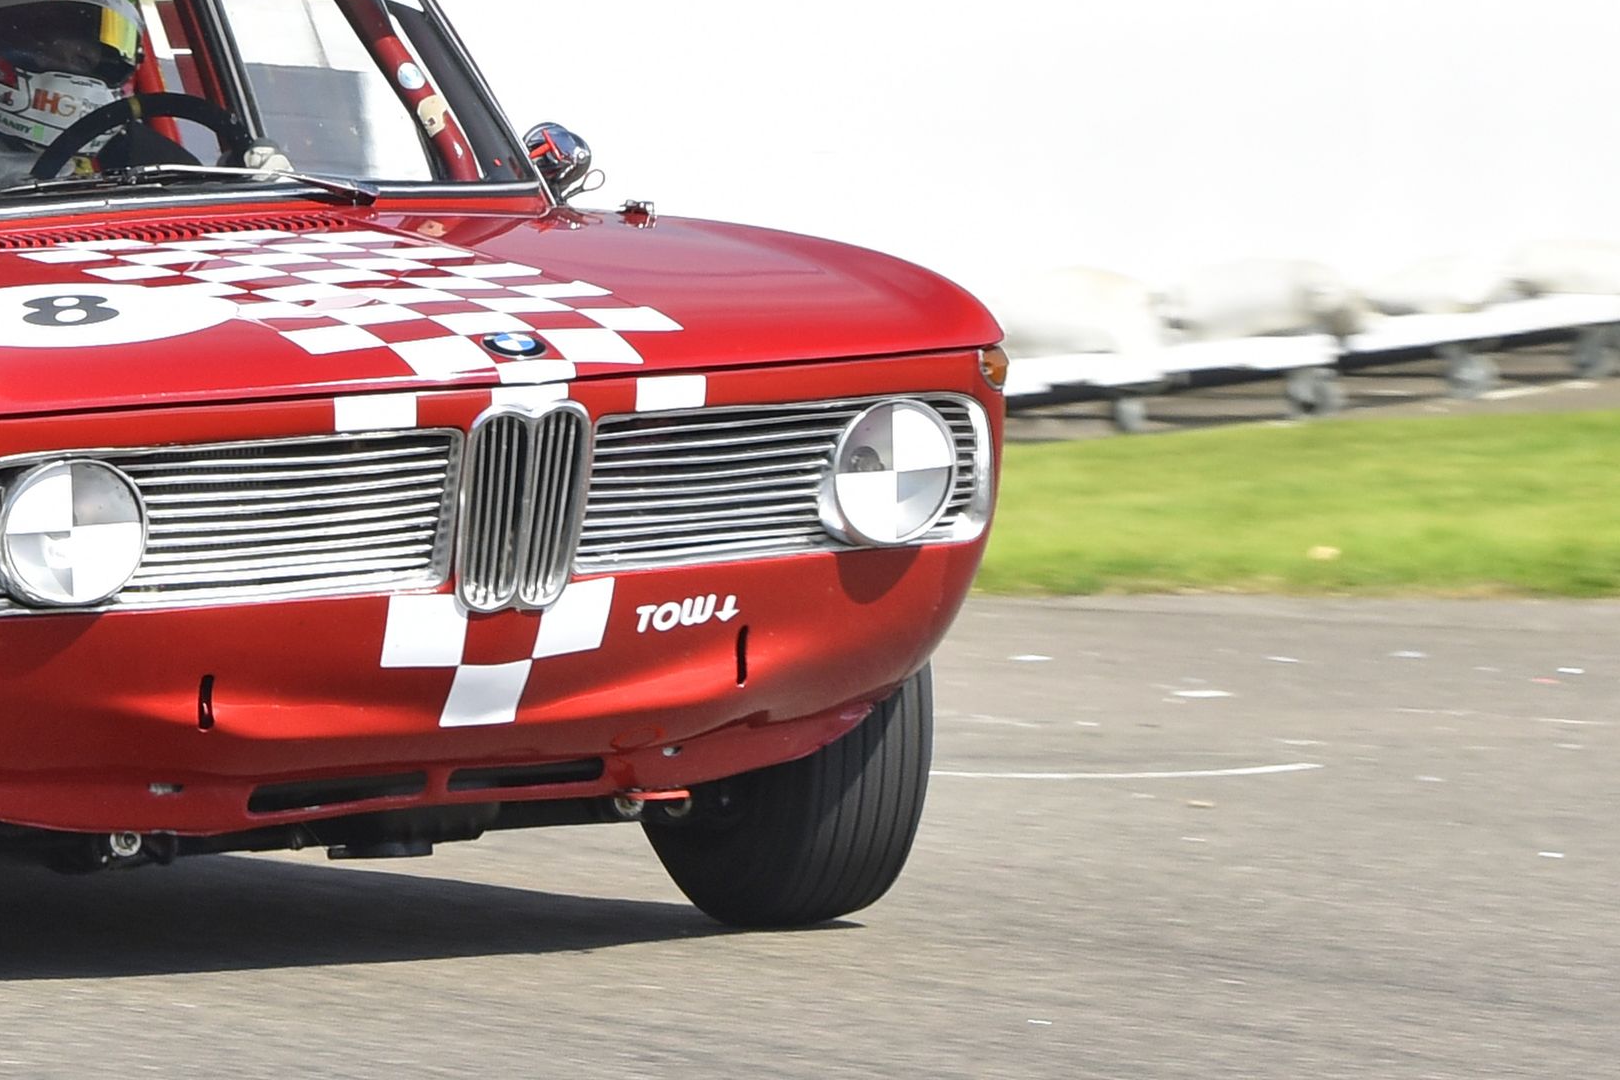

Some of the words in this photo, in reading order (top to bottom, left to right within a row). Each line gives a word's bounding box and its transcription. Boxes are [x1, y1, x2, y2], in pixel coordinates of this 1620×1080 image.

[31, 87, 78, 118] IHG
[22, 295, 120, 327] 8
[636, 593, 718, 633] TOW
